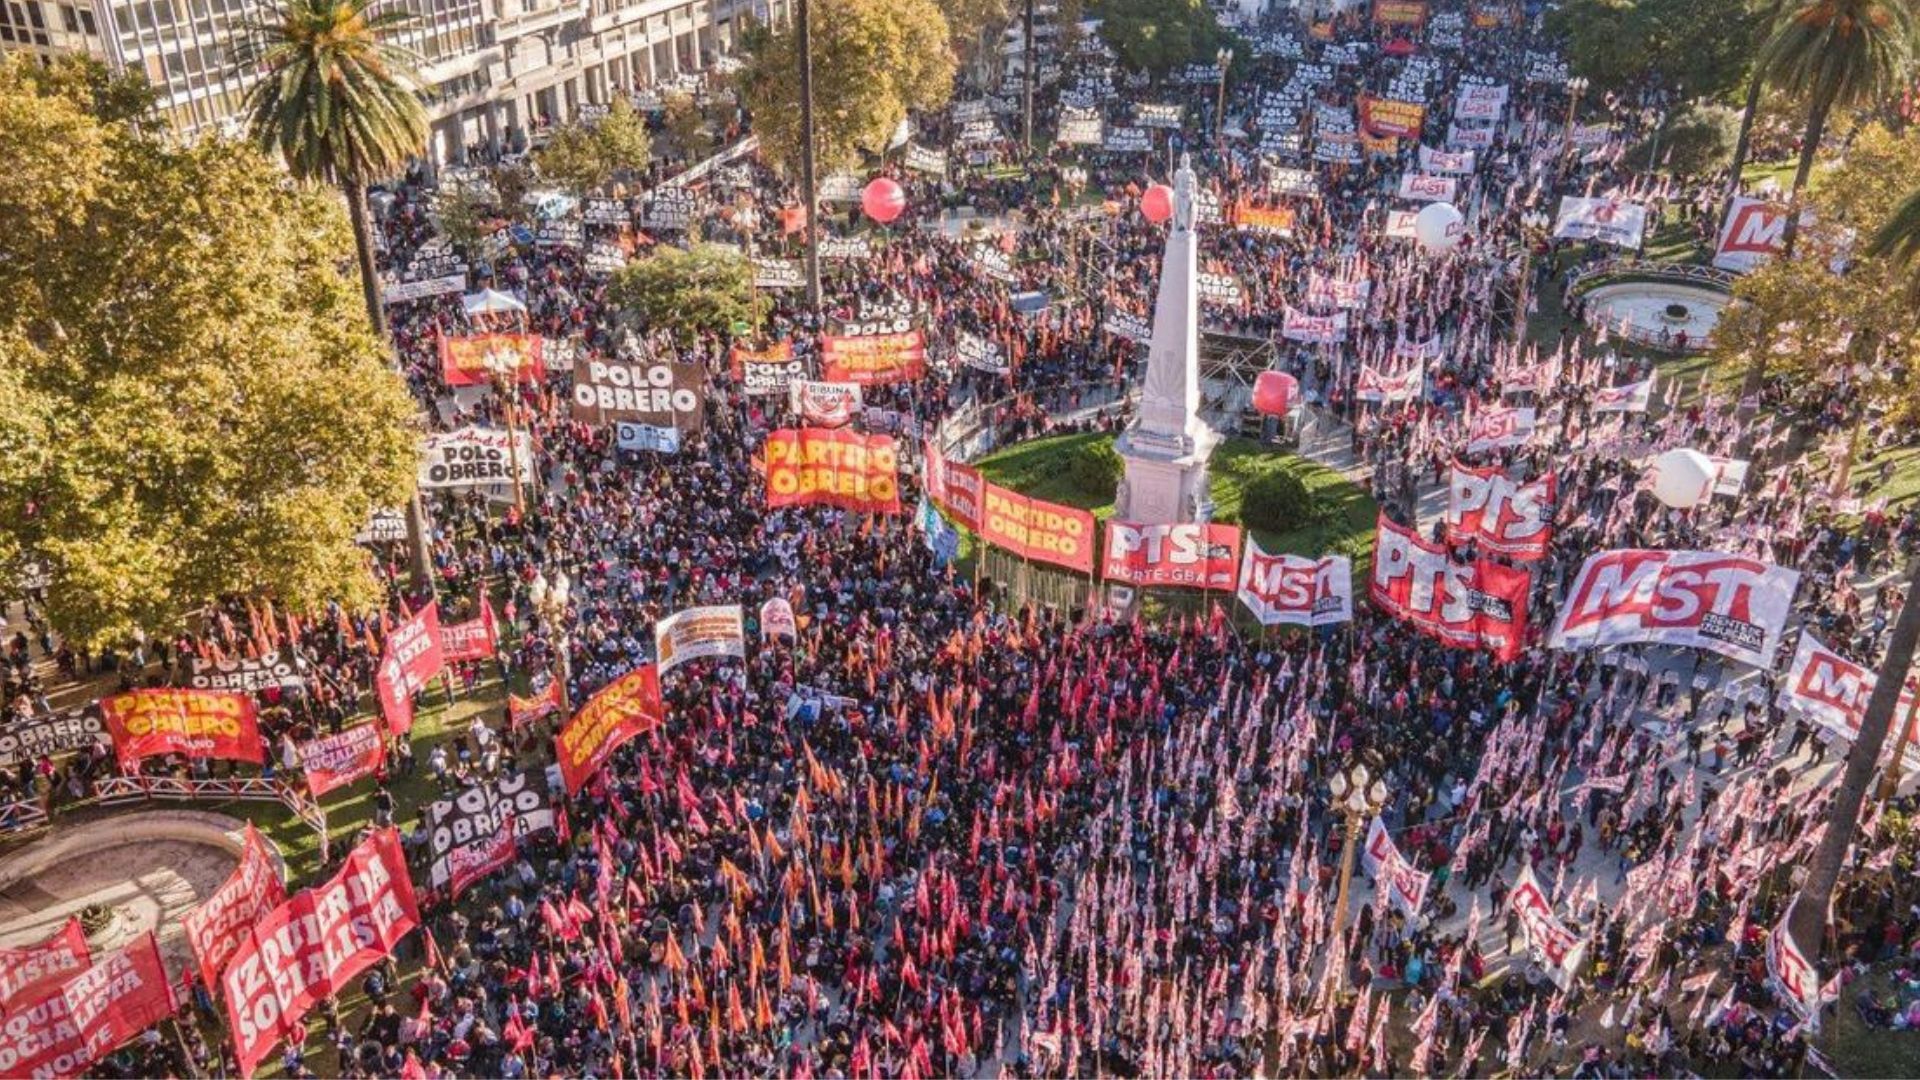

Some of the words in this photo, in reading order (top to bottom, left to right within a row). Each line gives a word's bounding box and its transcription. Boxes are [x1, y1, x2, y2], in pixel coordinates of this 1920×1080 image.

[1297, 62, 1331, 73] POLO
[1460, 74, 1495, 85] POLO
[1261, 108, 1291, 117] POLO
[1114, 128, 1145, 137] POLO
[656, 187, 694, 200] POLO
[1411, 177, 1446, 195] MST
[590, 361, 673, 387] POLO
[744, 360, 802, 375] POLO
[575, 384, 697, 412] OBRERO
[443, 445, 502, 463] POLO
[767, 439, 896, 472] PARTIDO
[429, 462, 523, 483] OBRERO
[772, 467, 895, 500] OBRERO
[984, 492, 1084, 538] PARTIDO
[1451, 468, 1550, 541] PTS
[988, 512, 1079, 556] OBRERO
[1111, 523, 1200, 564] PTS
[1246, 552, 1334, 610] MST
[1375, 523, 1478, 622] PTS
[1563, 550, 1766, 630] MST
[191, 663, 292, 689] OBRERO
[192, 651, 279, 675] POLO
[113, 693, 241, 716] PARTIDO
[564, 674, 642, 753] PARTIDO
[0, 717, 101, 753] OBRERO
[126, 714, 242, 738] OBRERO
[572, 697, 641, 766] OBRERO
[431, 773, 525, 825] POLO
[433, 790, 540, 855] OBRERO
[227, 853, 391, 1012] IZQUIERDA
[238, 891, 405, 1053] SOCIALISTA
